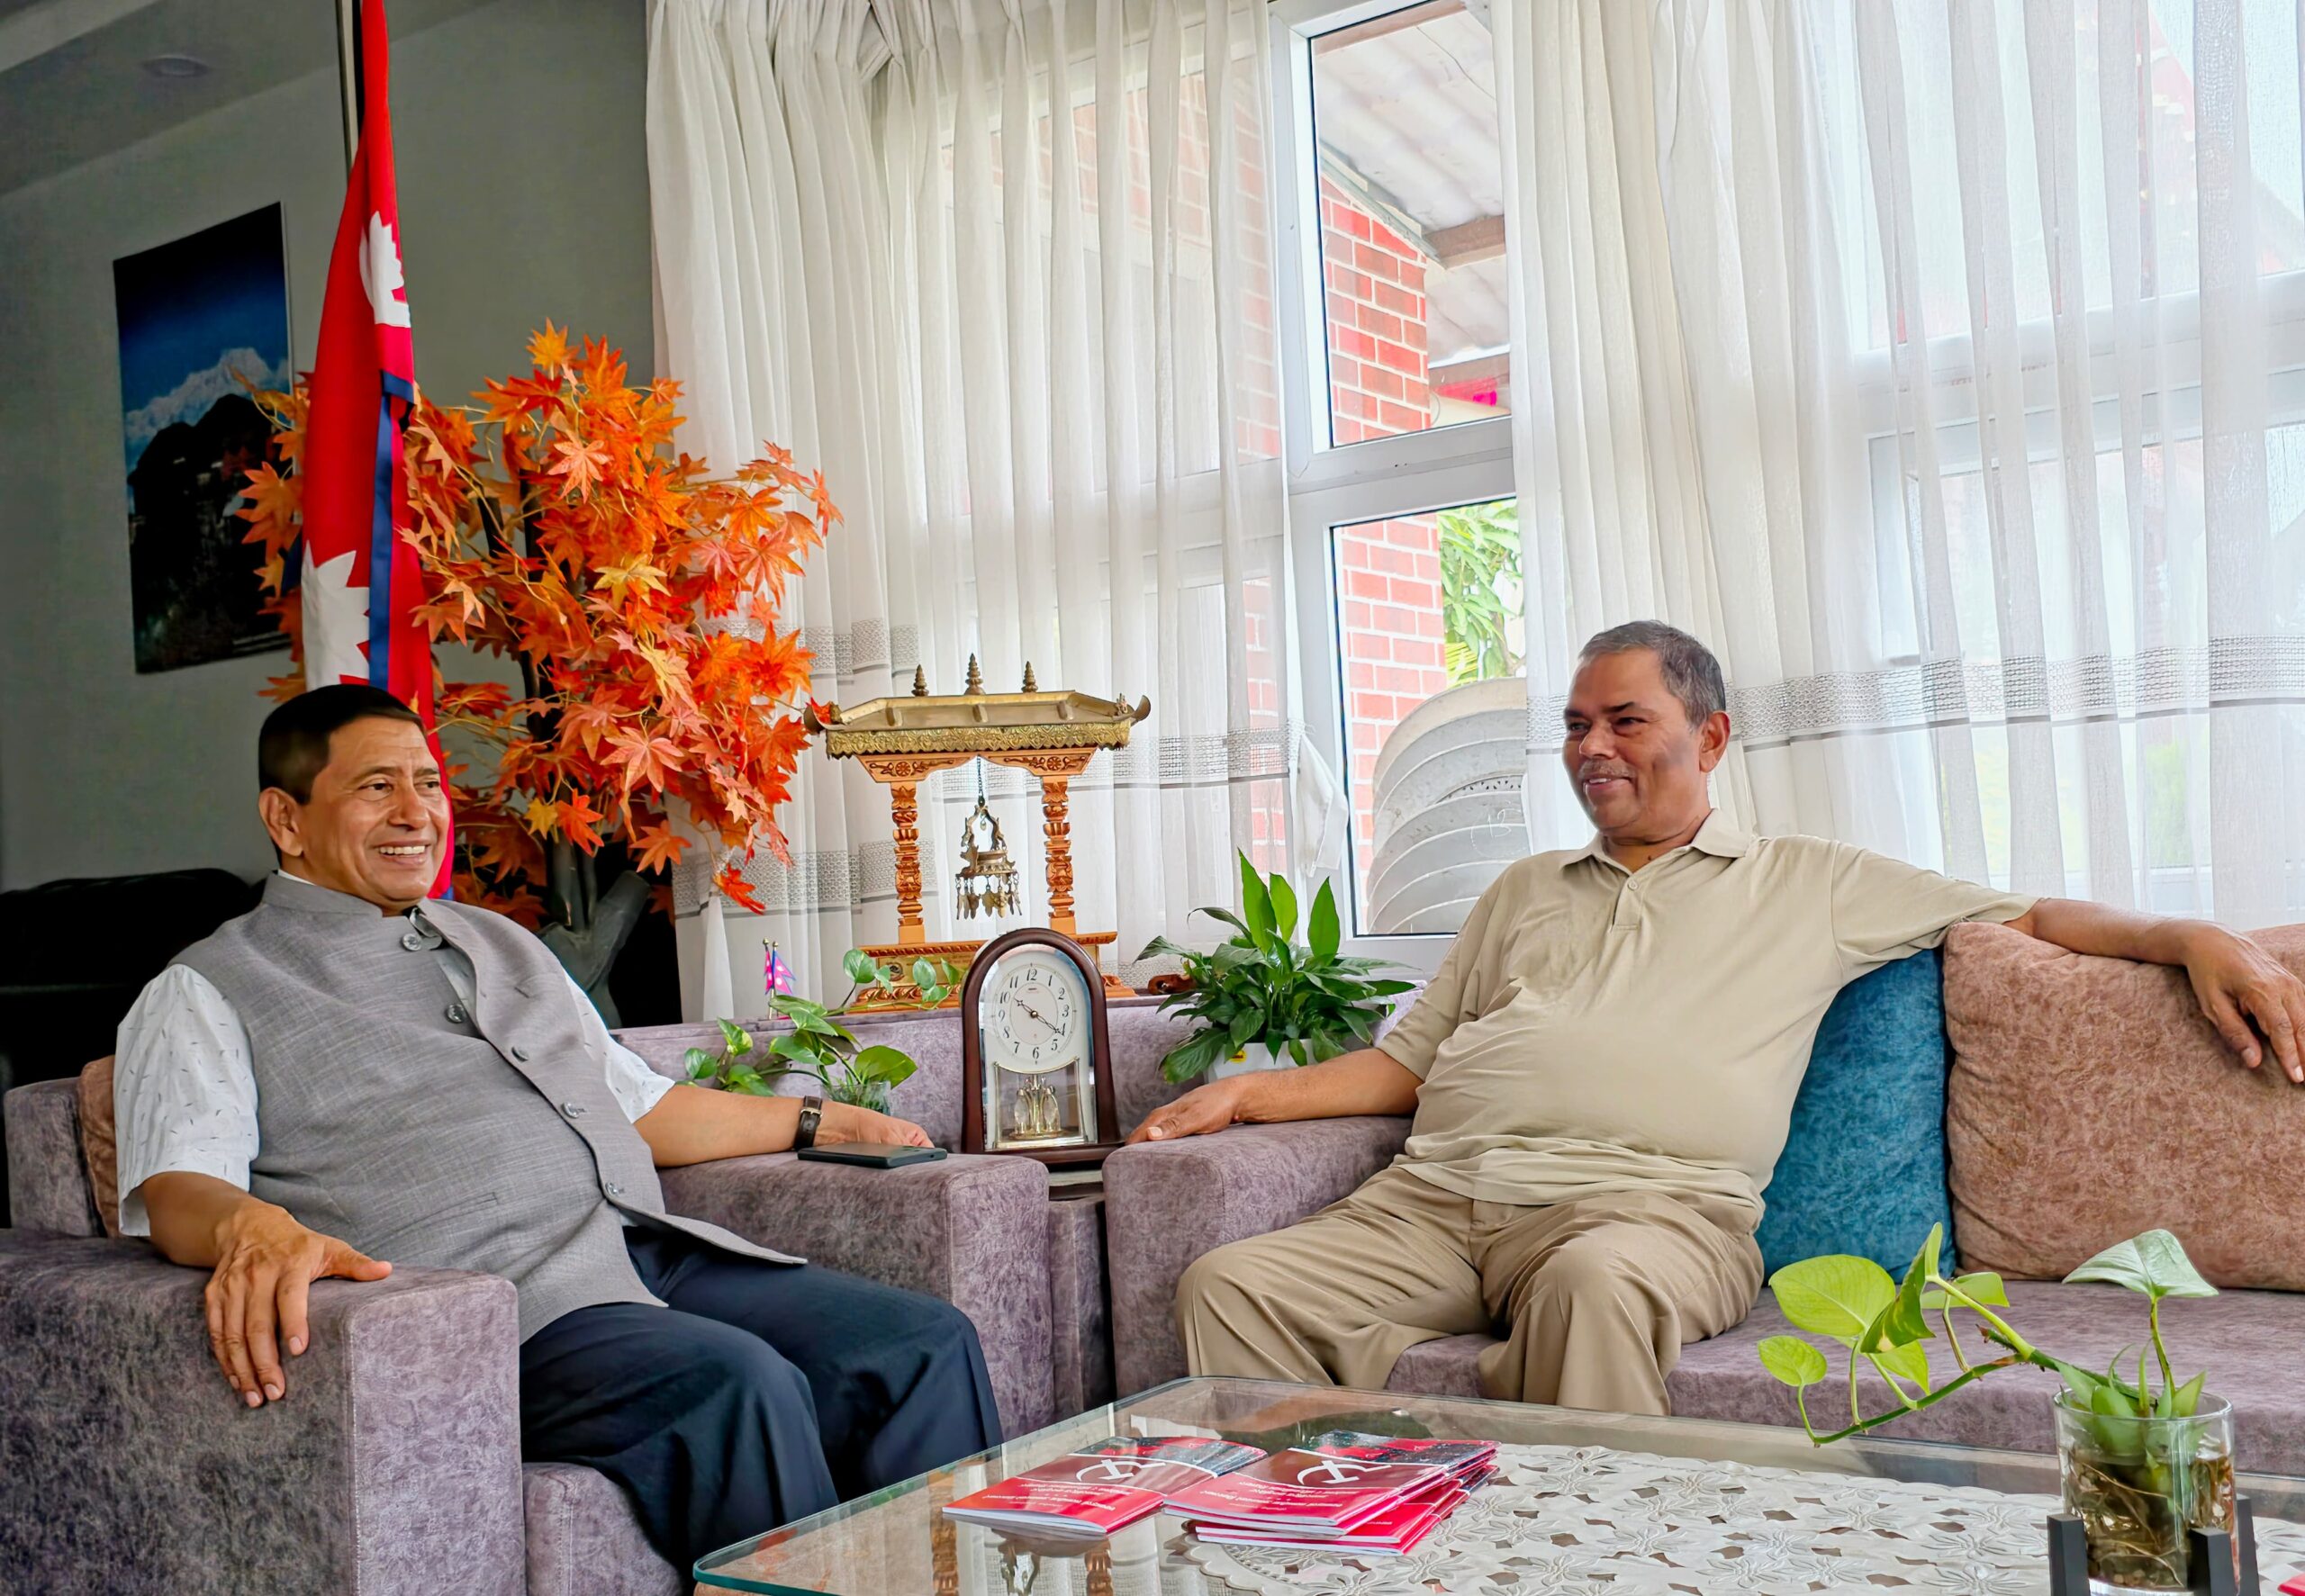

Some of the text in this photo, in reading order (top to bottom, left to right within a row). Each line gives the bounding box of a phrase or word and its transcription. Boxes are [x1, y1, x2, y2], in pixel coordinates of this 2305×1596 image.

[1026, 969, 1037, 981] 12
[1048, 975, 1053, 987] 1
[1009, 976, 1018, 988] 11
[1000, 992, 1010, 1004] 10
[1058, 987, 1065, 1000] 2
[999, 1010, 1005, 1023] 9
[1062, 1005, 1070, 1017] 3
[1003, 1026, 1010, 1038] 8
[1014, 1041, 1020, 1053] 7
[1051, 1039, 1058, 1050] 5
[1032, 1047, 1039, 1059] 6
